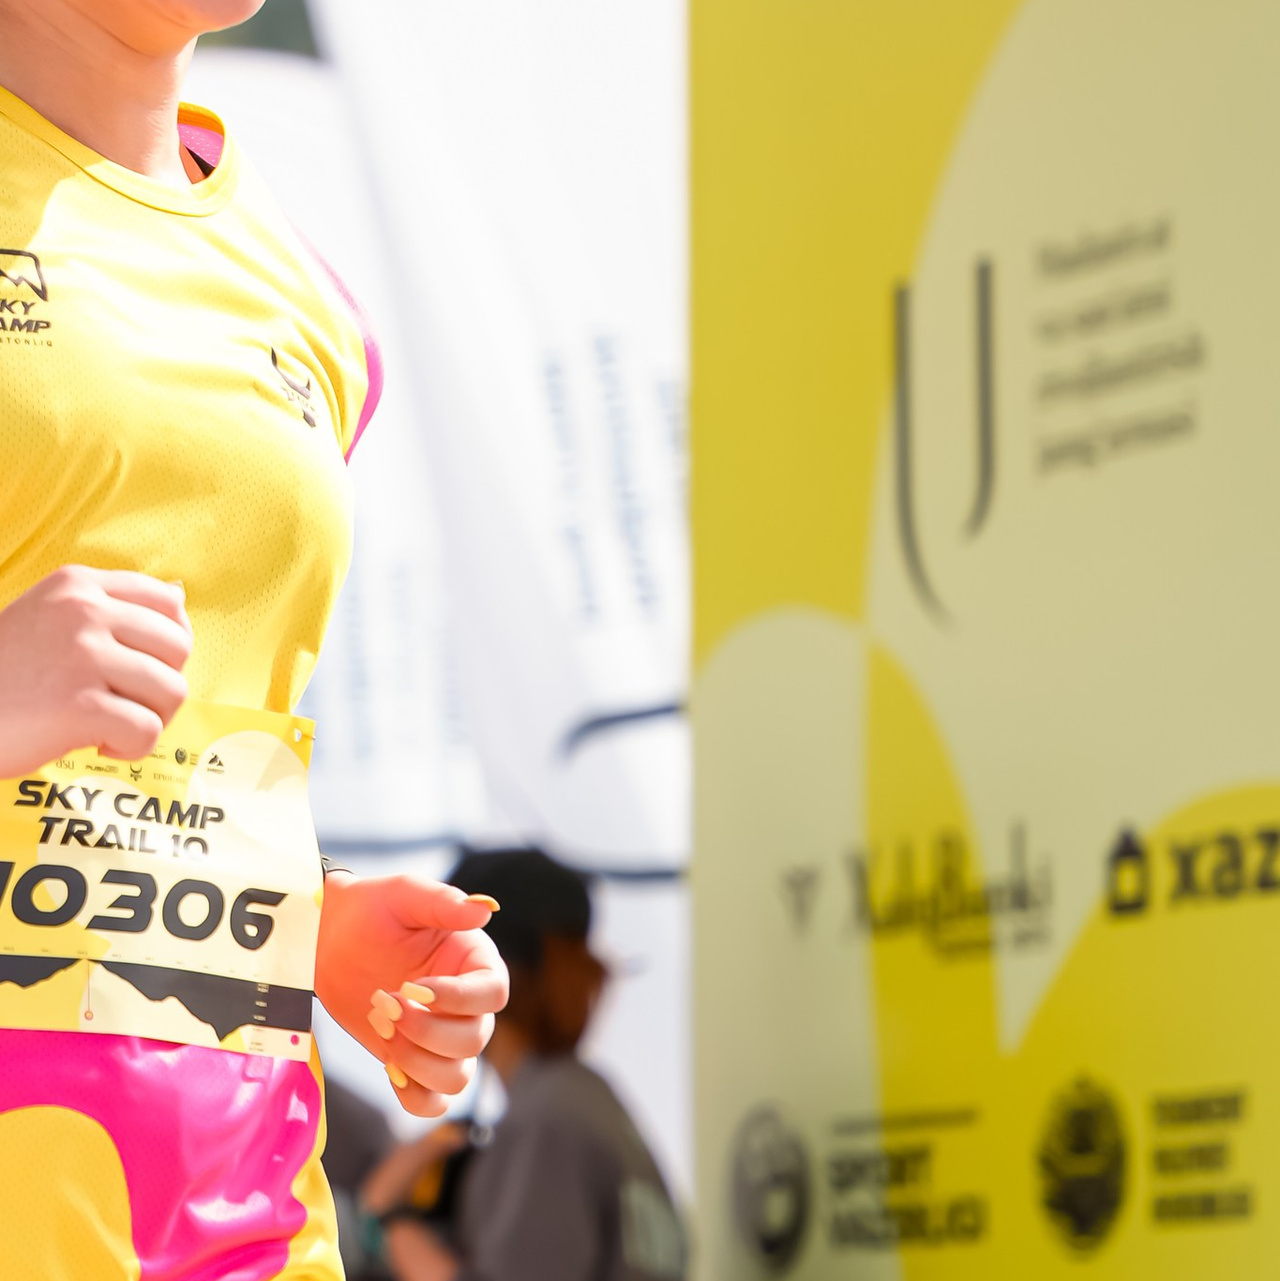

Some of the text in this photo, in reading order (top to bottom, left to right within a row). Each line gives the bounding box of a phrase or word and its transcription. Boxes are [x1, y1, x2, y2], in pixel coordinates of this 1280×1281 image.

[13, 779, 226, 831] SKY CAMP
[37, 815, 210, 862] TRAIL 10
